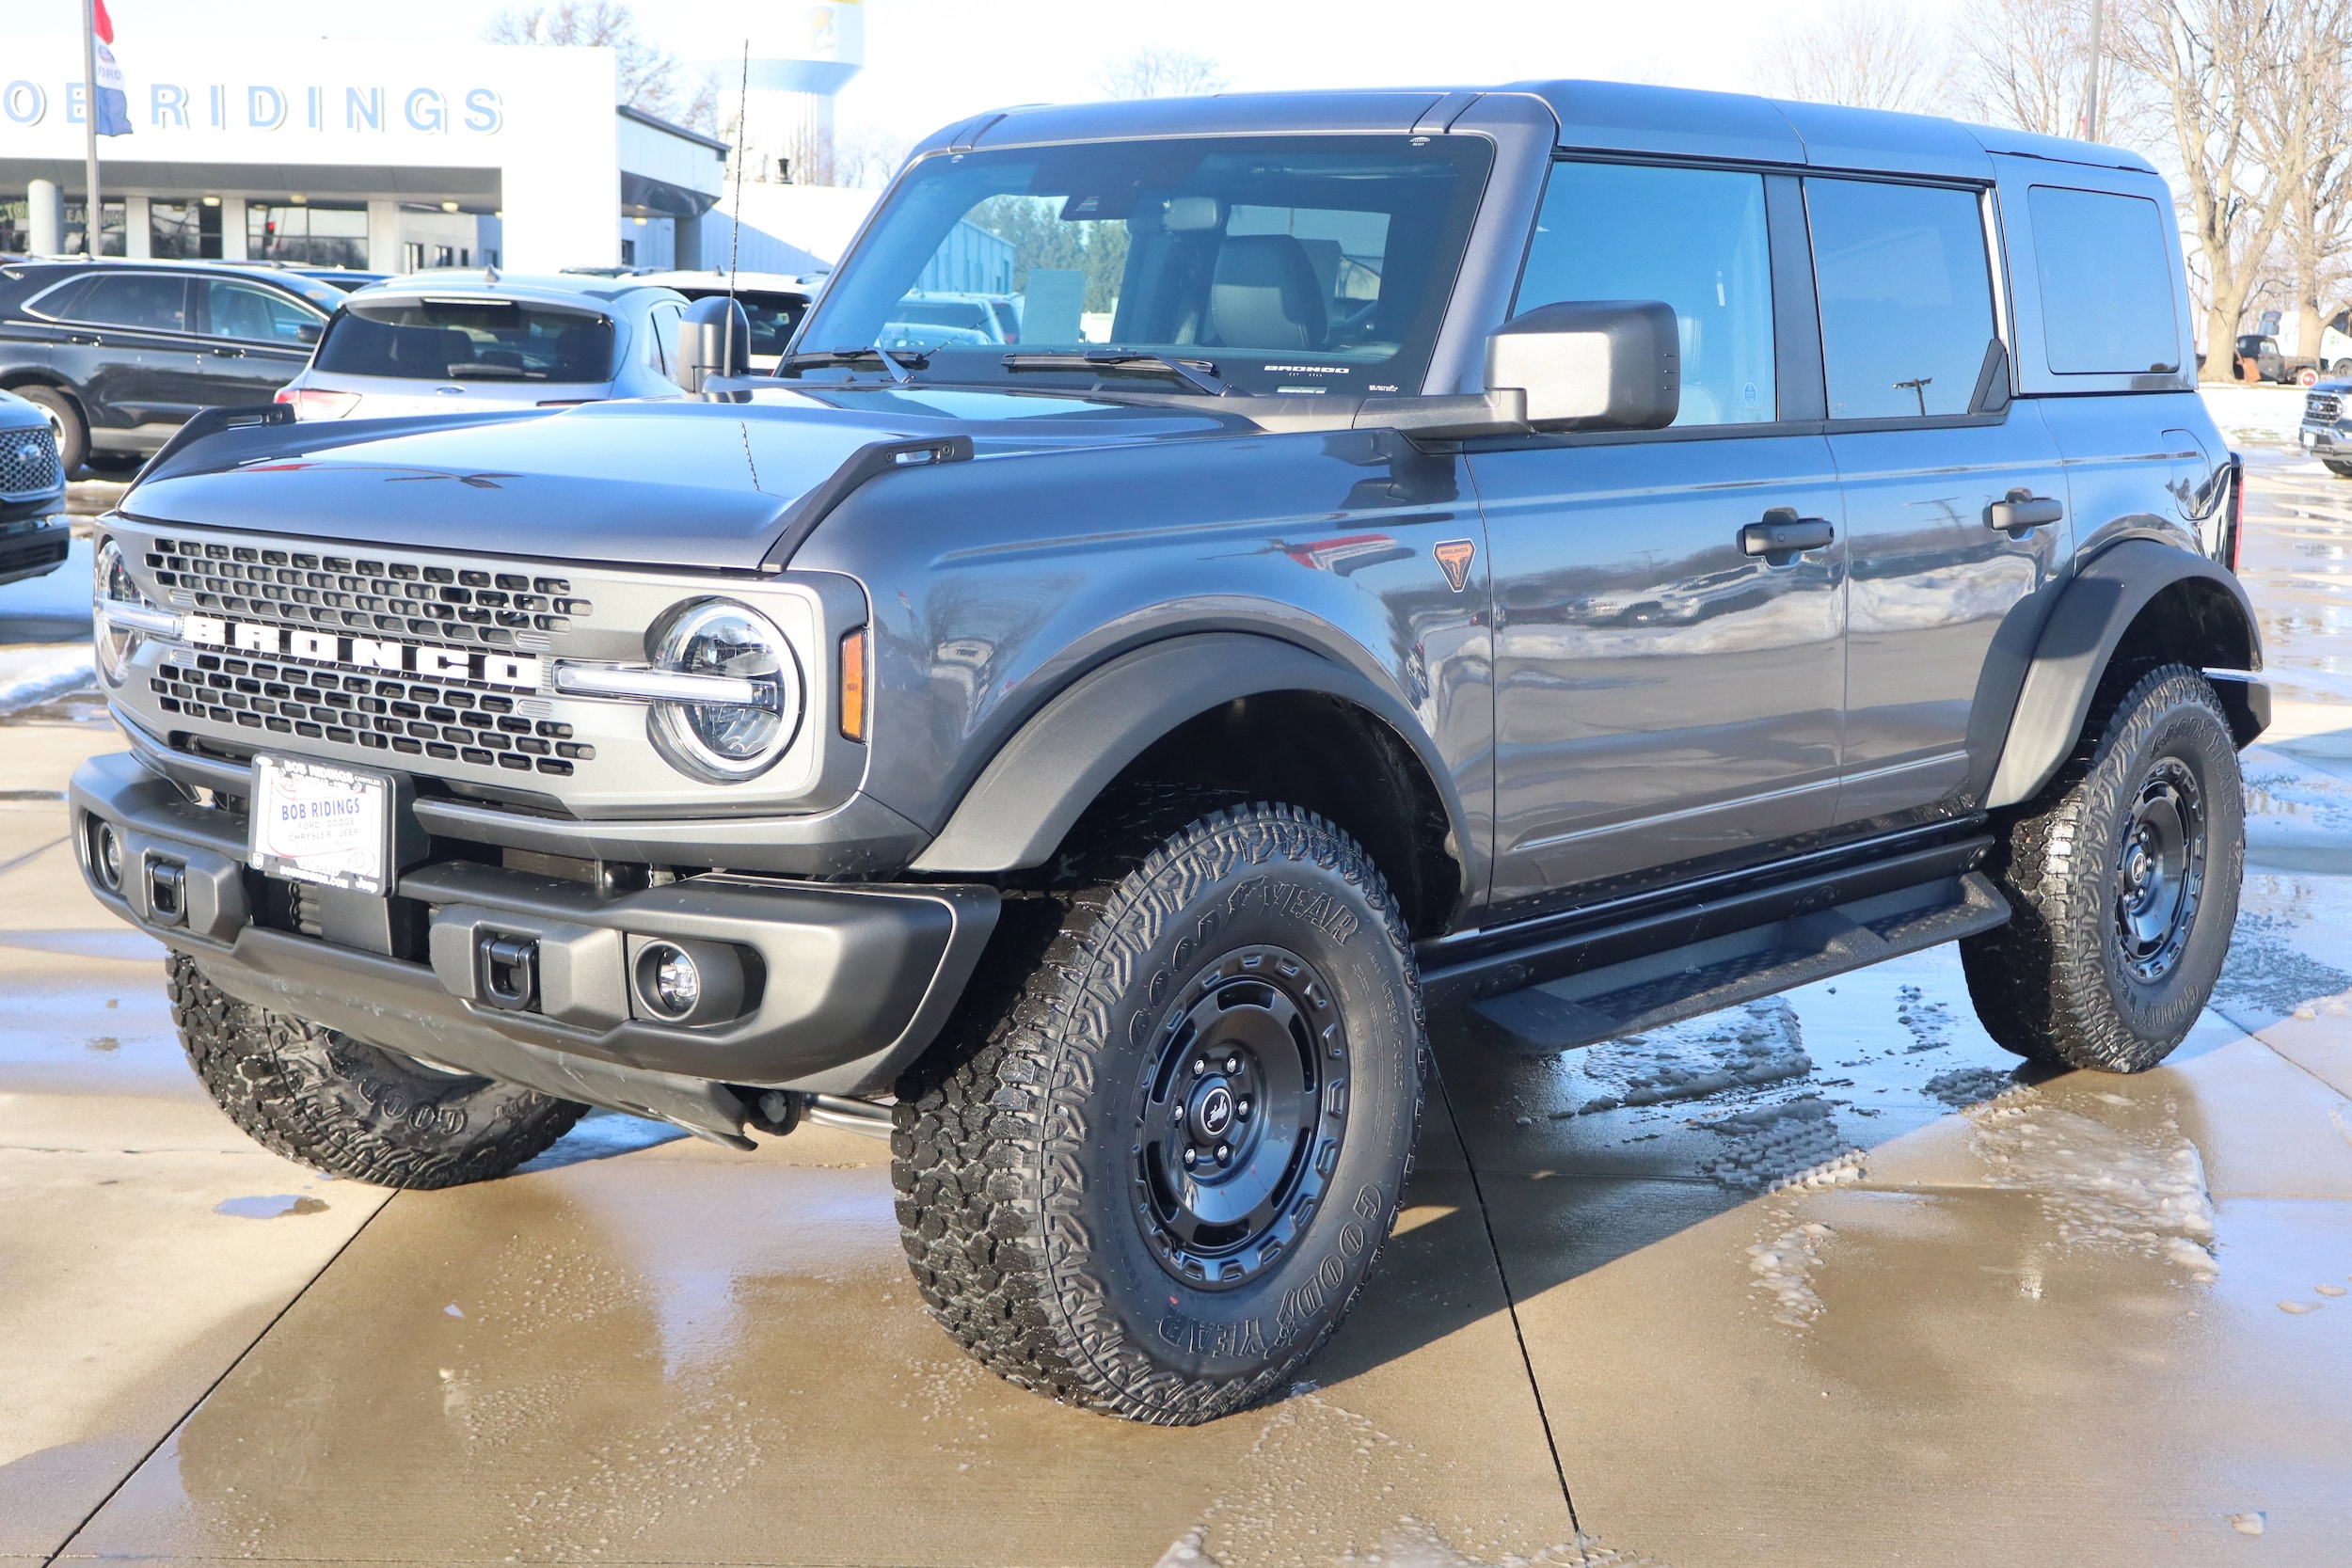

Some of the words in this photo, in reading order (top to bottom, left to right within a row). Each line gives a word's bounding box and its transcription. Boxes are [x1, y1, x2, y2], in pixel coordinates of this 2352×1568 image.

[151, 84, 502, 134] RIDINGS
[1263, 365, 1350, 373] BRONCO
[183, 614, 539, 689] BRONCO
[283, 760, 308, 775] BOB
[308, 765, 355, 784] RIDINGS
[281, 803, 307, 822] BOB
[311, 797, 361, 818] RIDINGS
[288, 830, 332, 843] CHRYSLER
[338, 828, 359, 838] JEEP
[298, 820, 321, 831] FORD
[327, 817, 356, 829] DODGE
